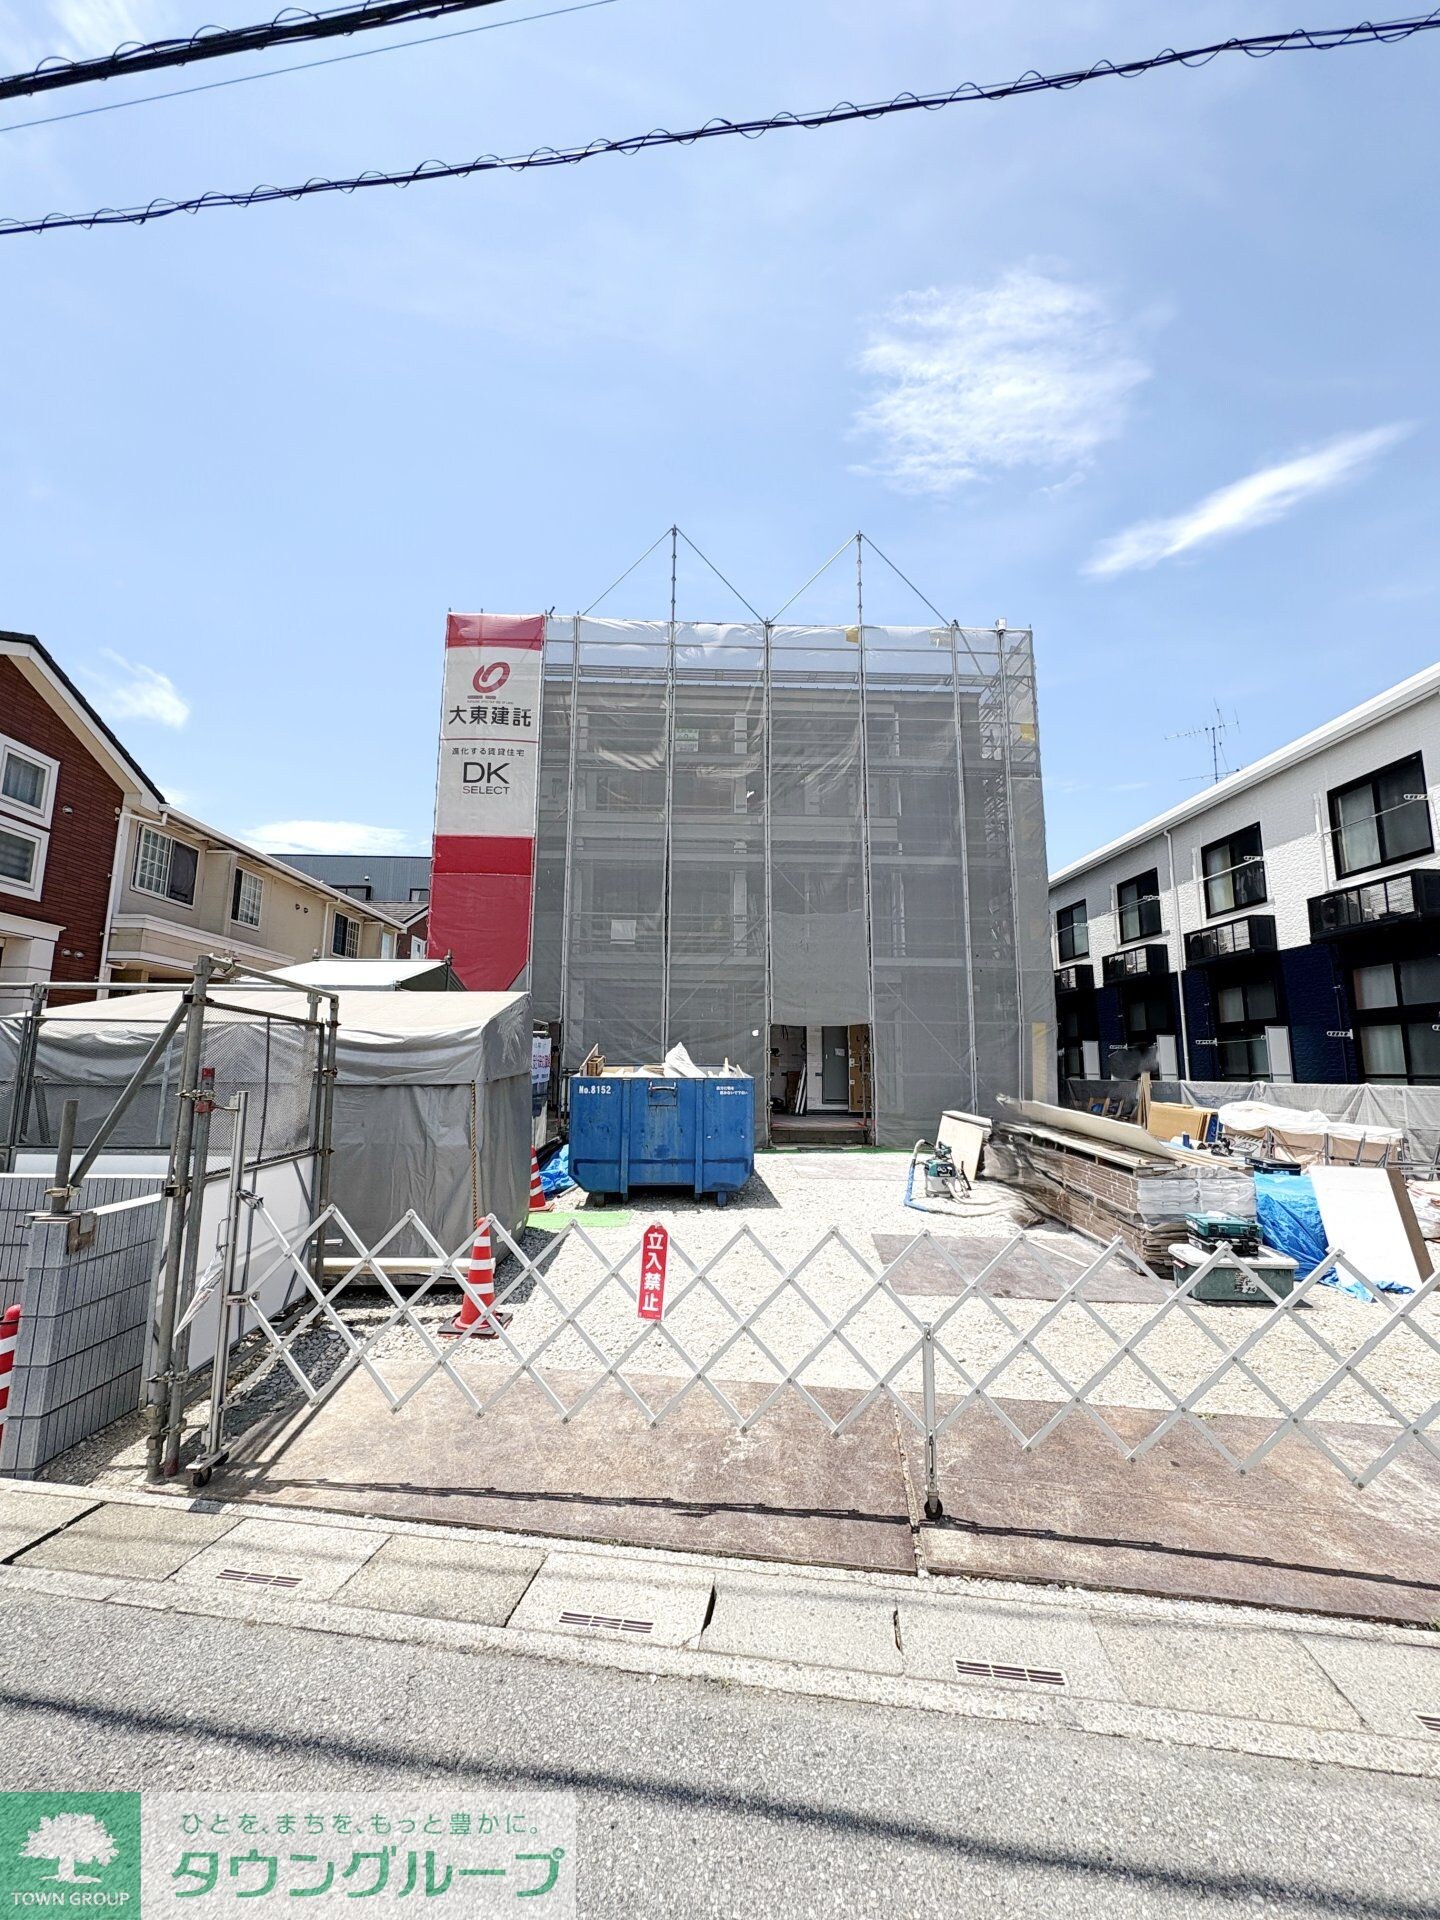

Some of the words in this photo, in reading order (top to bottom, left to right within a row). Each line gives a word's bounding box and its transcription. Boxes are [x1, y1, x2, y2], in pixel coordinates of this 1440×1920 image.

[448, 705, 532, 727] 大東建託
[452, 747, 525, 757] 進化する賃貸住宅
[463, 761, 511, 785] DK
[462, 785, 511, 795] SELECT
[578, 1085, 611, 1095] No.8152
[642, 1231, 664, 1312] 立入禁止
